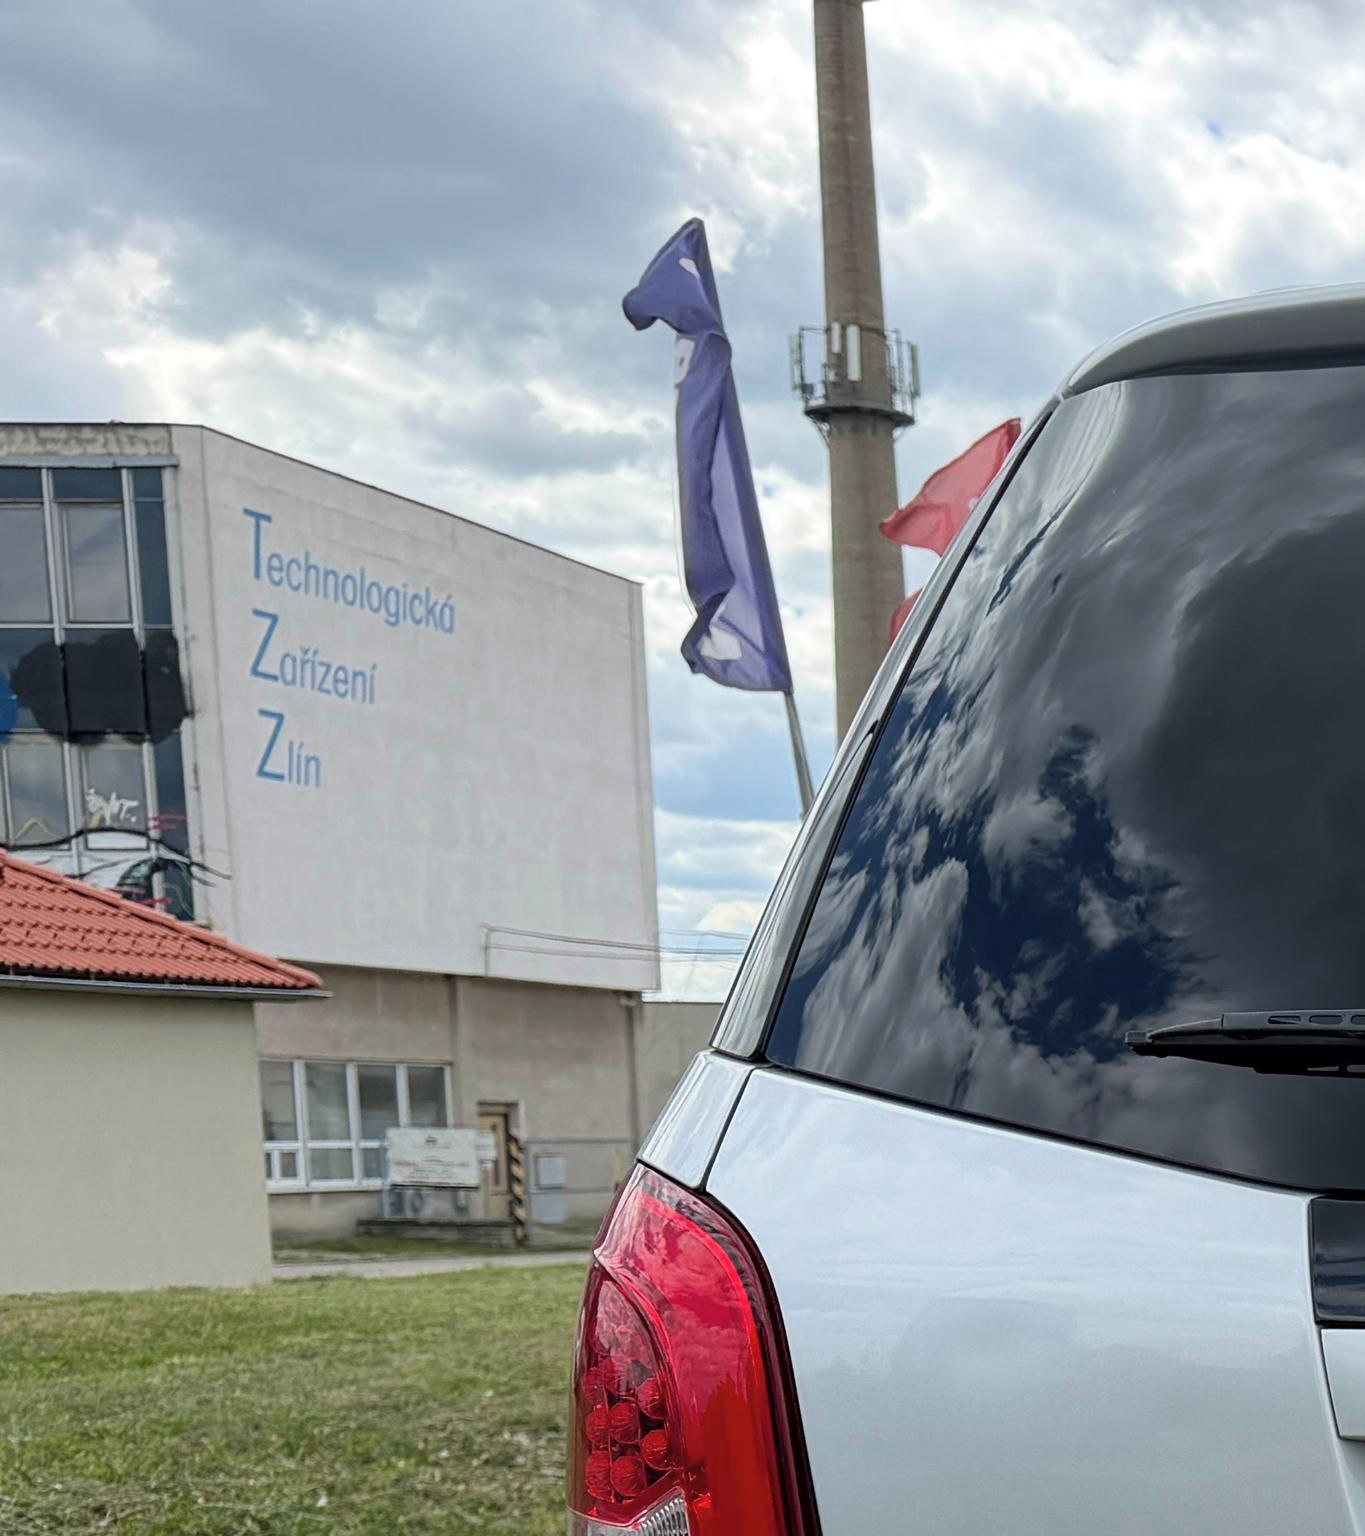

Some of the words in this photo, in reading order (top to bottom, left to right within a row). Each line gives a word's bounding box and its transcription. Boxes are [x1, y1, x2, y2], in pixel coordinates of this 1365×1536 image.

[242, 508, 455, 634] Technologická
[250, 608, 378, 704] Zařízení
[256, 709, 321, 788] Zlín
